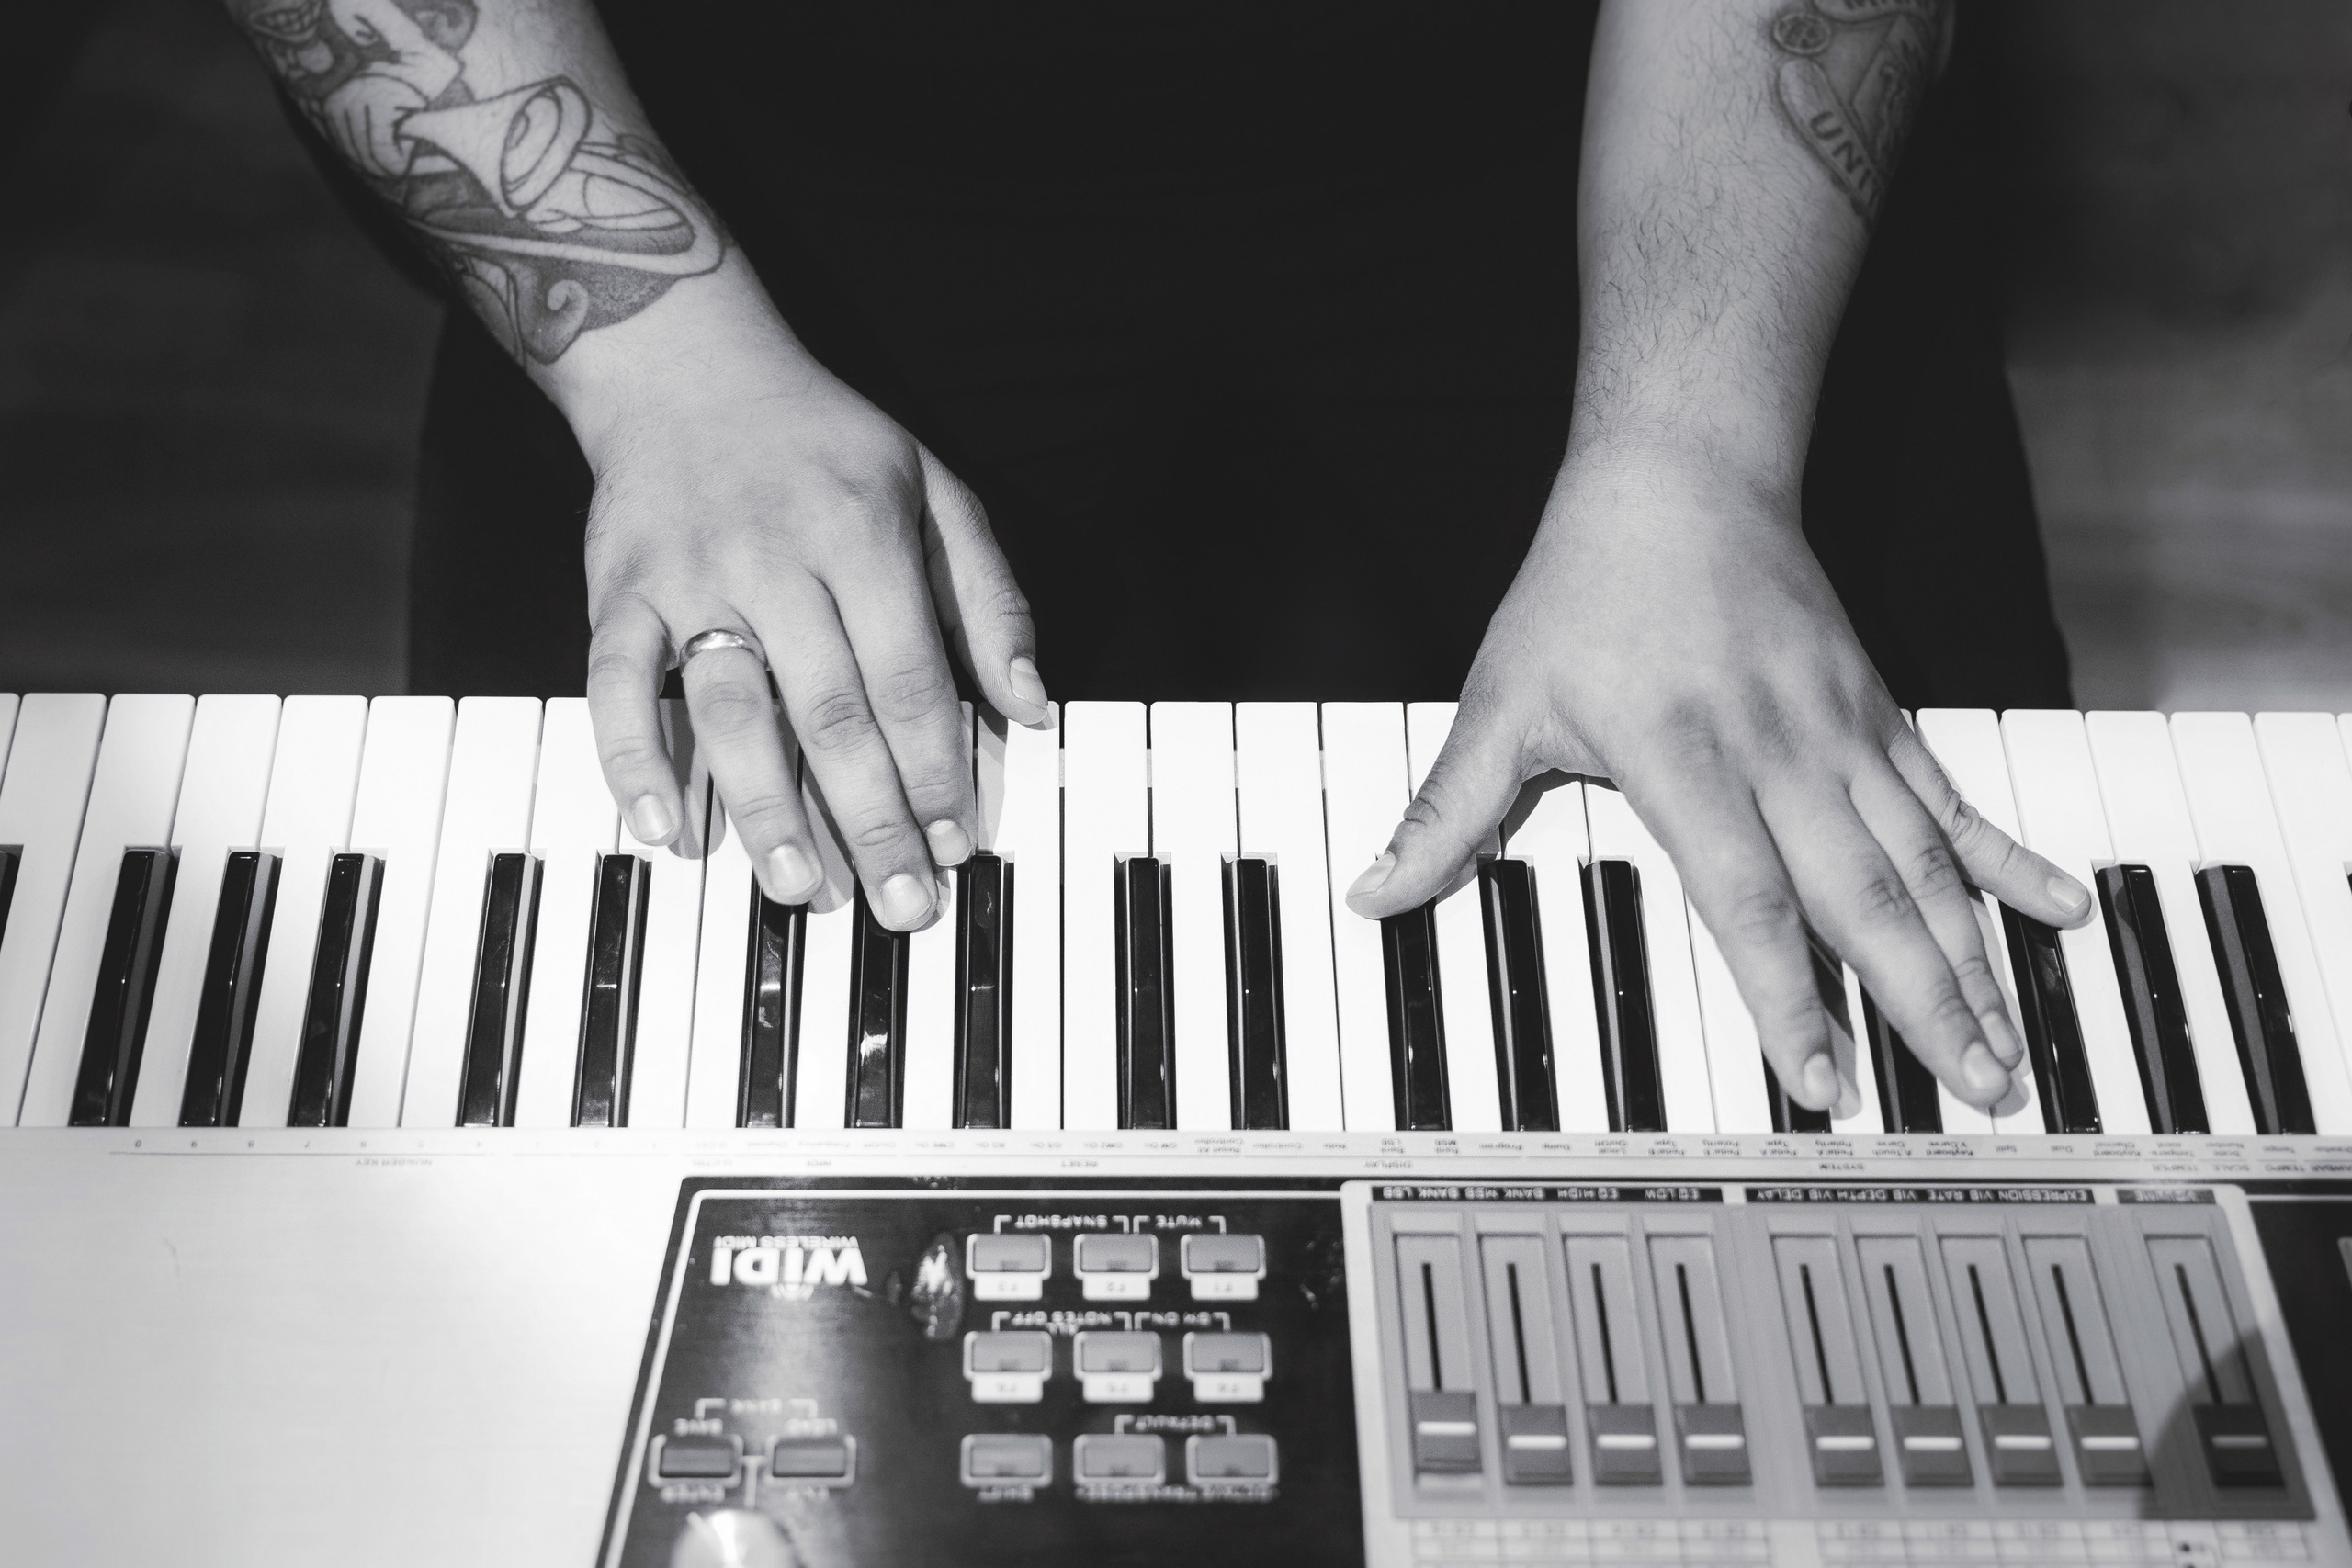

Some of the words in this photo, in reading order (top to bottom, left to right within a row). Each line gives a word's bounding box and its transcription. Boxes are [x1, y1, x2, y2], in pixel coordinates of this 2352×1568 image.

[1653, 1138, 1679, 1148] Type
[1702, 1138, 1740, 1148] Polarity
[1764, 1139, 1790, 1148] Type
[1814, 1138, 1853, 1148] Polarity
[1875, 1140, 1905, 1148] Curve
[1994, 1143, 2018, 1154] Split
[2094, 1142, 2136, 1150] Channel
[2205, 1142, 2245, 1150] Number
[1926, 1145, 1974, 1157] Keyboard
[2050, 1145, 2074, 1154] Dual
[2092, 1148, 2141, 1158] Keyboard
[355, 1158, 379, 1167] KEY
[2211, 1163, 2251, 1172] SCALE
[2264, 1164, 2305, 1172] TEMPO
[1382, 1187, 1414, 1201] LSB
[1418, 1187, 1460, 1201] BANK
[1502, 1187, 1545, 1201] BANK
[1756, 1189, 1803, 1201] DELAY
[1808, 1189, 1833, 1201] VIB
[1837, 1189, 1887, 1201] DEPTH
[1893, 1189, 1917, 1201] VIB
[1928, 1189, 1963, 1201] RATE
[1969, 1189, 1993, 1201] VIB
[1997, 1189, 2087, 1201] EXPRESSION
[1014, 1215, 1108, 1228] SNAPSHOT
[1154, 1215, 1202, 1228] MUTE
[712, 1235, 758, 1249] MIDI
[760, 1235, 859, 1249] WIRELESS
